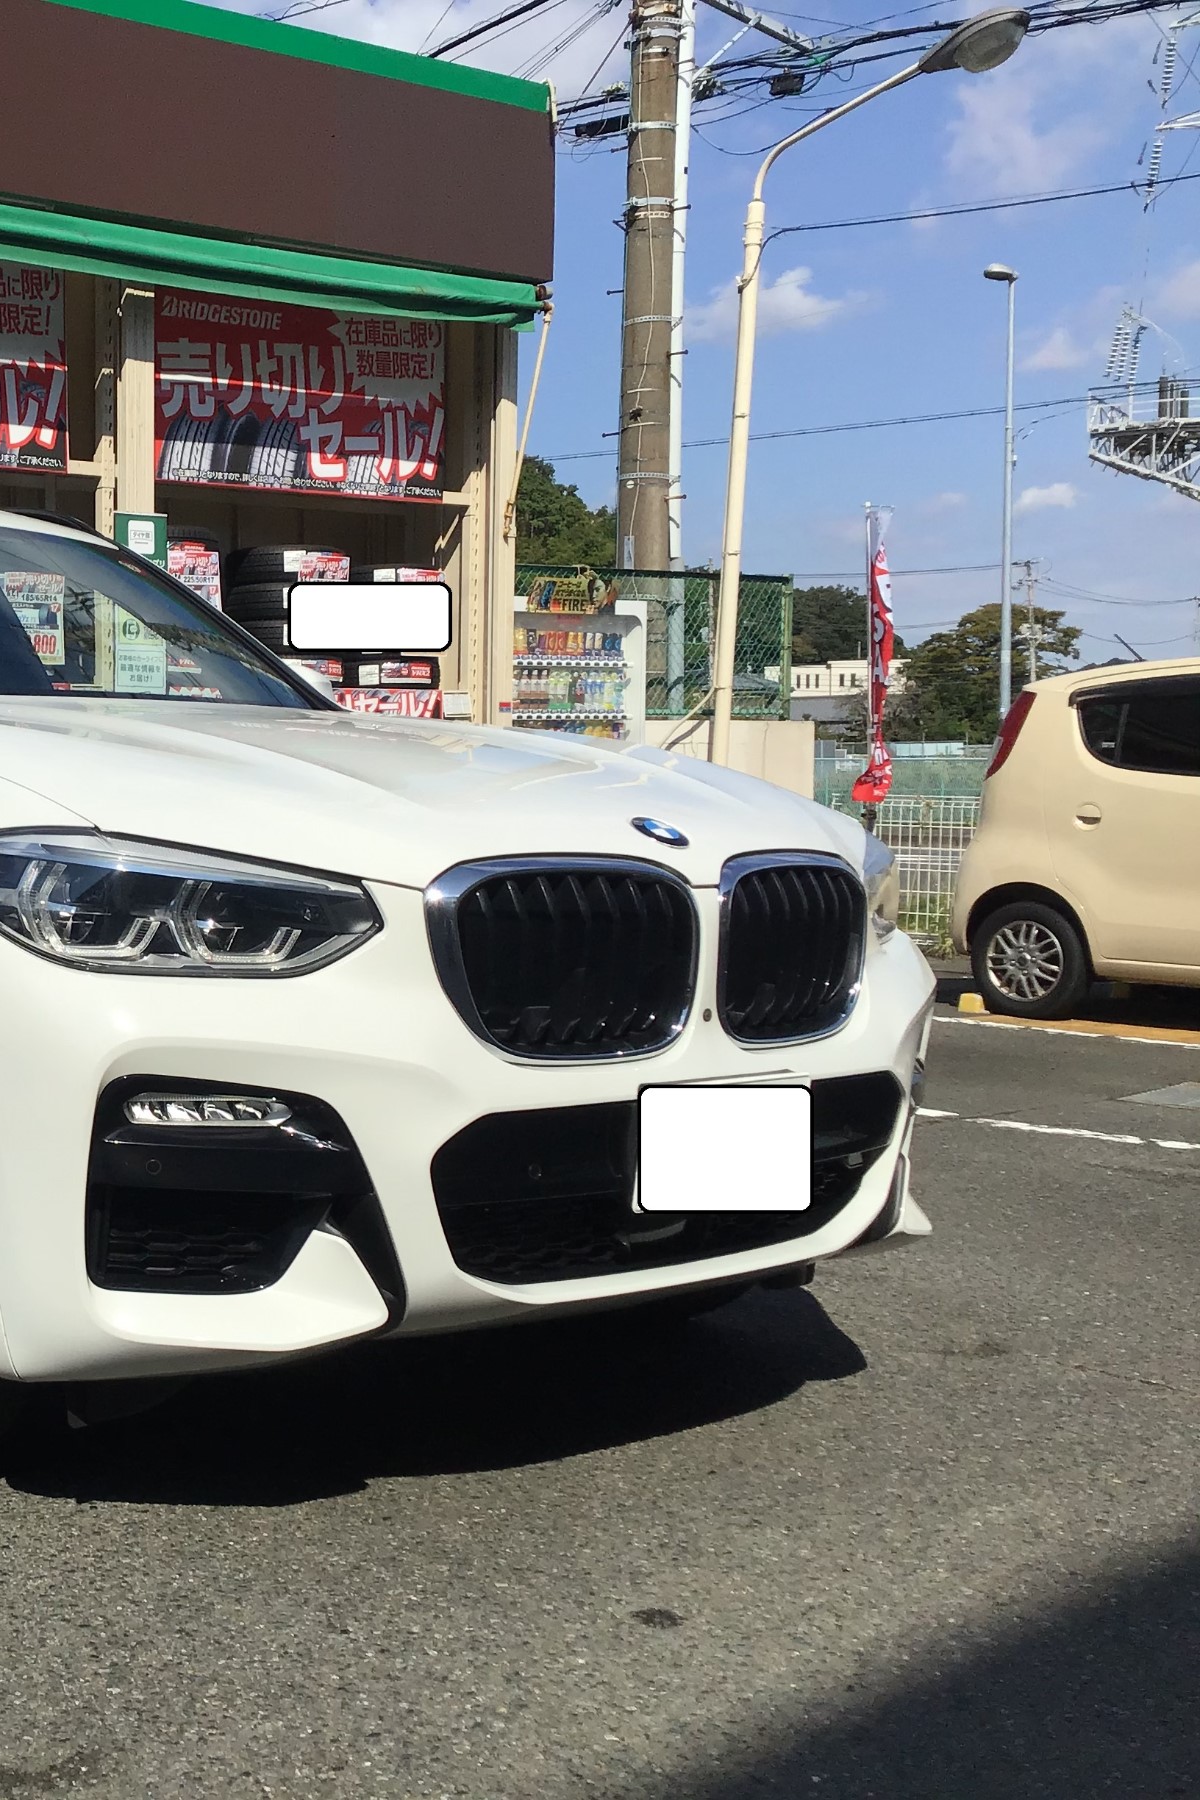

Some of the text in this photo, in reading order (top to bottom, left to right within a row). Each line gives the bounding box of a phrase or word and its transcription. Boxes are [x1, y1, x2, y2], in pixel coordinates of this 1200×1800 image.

[160, 294, 282, 331] BRIDGESTONE
[345, 317, 443, 350] 在庫品に限り
[156, 337, 345, 419] 売り切り
[356, 349, 436, 380] 数量限定!
[299, 408, 445, 482] セール!
[561, 598, 587, 611] FIRE
